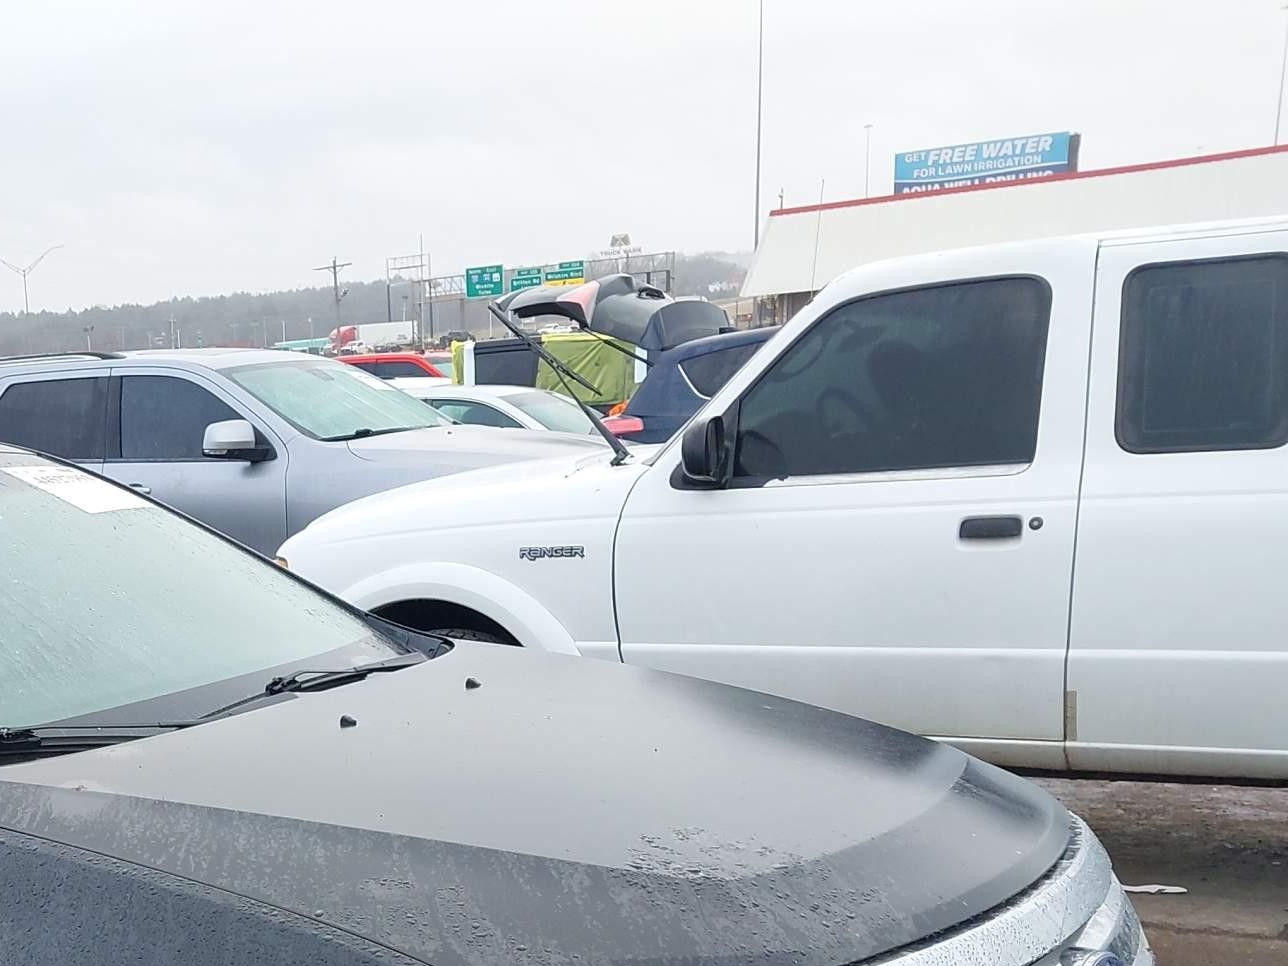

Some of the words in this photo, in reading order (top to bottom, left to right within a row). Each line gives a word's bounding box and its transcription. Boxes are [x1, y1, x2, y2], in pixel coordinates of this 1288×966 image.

[905, 152, 927, 163] GET
[927, 144, 978, 166] FREE
[982, 135, 1054, 160] WATER
[913, 167, 937, 179] FOR
[938, 162, 972, 176] LAWN
[974, 154, 1043, 171] IRRIGATION
[519, 546, 585, 561] RANGER
